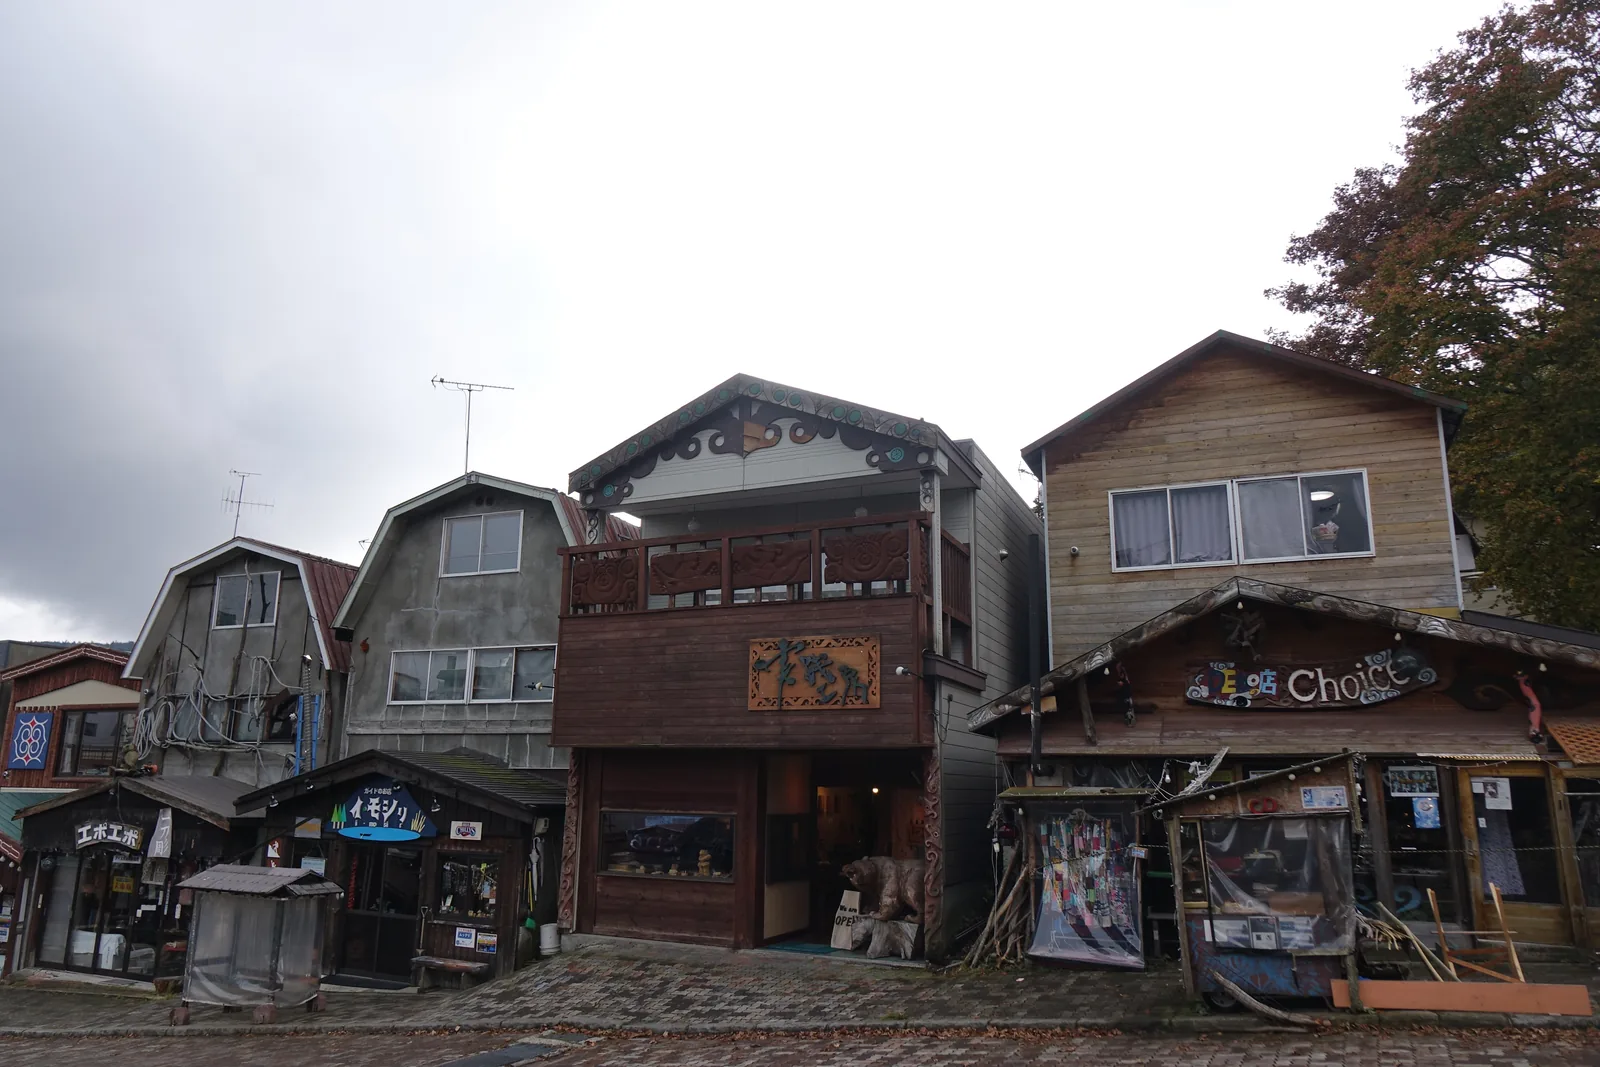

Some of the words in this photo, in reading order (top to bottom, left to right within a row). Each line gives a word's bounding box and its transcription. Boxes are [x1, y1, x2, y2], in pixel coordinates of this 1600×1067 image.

[1288, 658, 1411, 703] Choice
[77, 822, 139, 847] エポエポ
